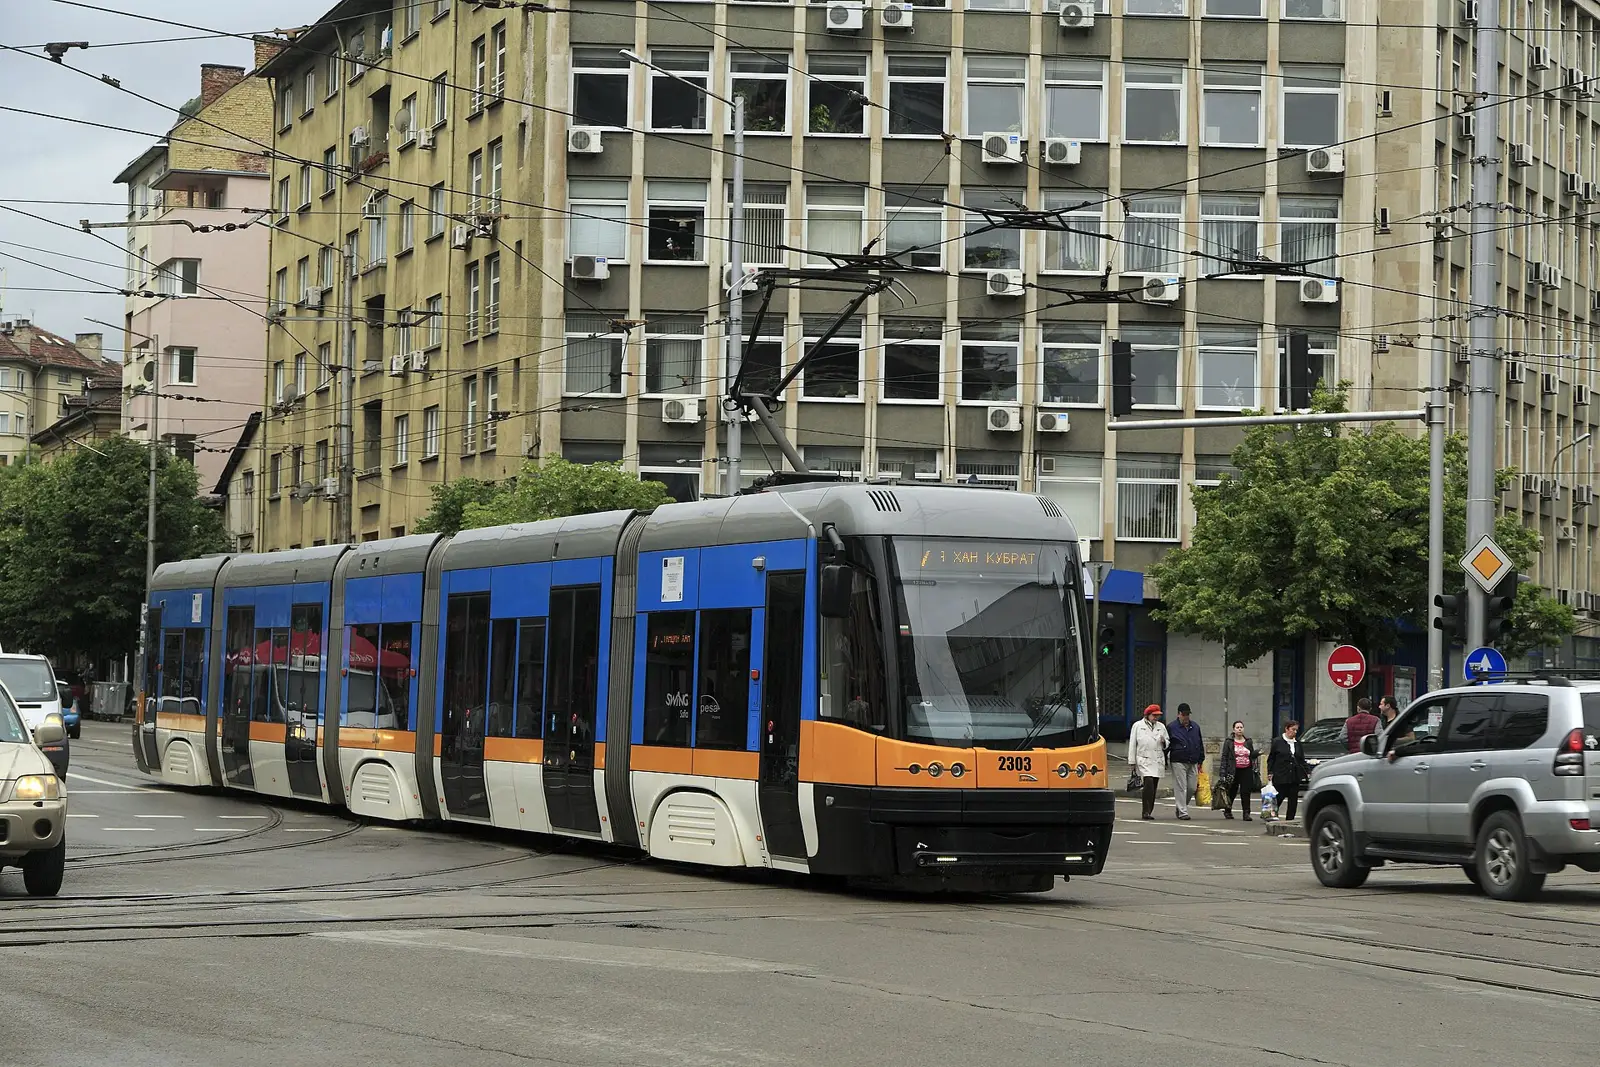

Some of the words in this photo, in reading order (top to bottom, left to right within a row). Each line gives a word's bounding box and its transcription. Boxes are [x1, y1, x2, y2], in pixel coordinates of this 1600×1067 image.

[953, 551, 978, 563] ХАН
[986, 552, 1036, 565] КУБРАТ
[997, 755, 1032, 772] 2303
